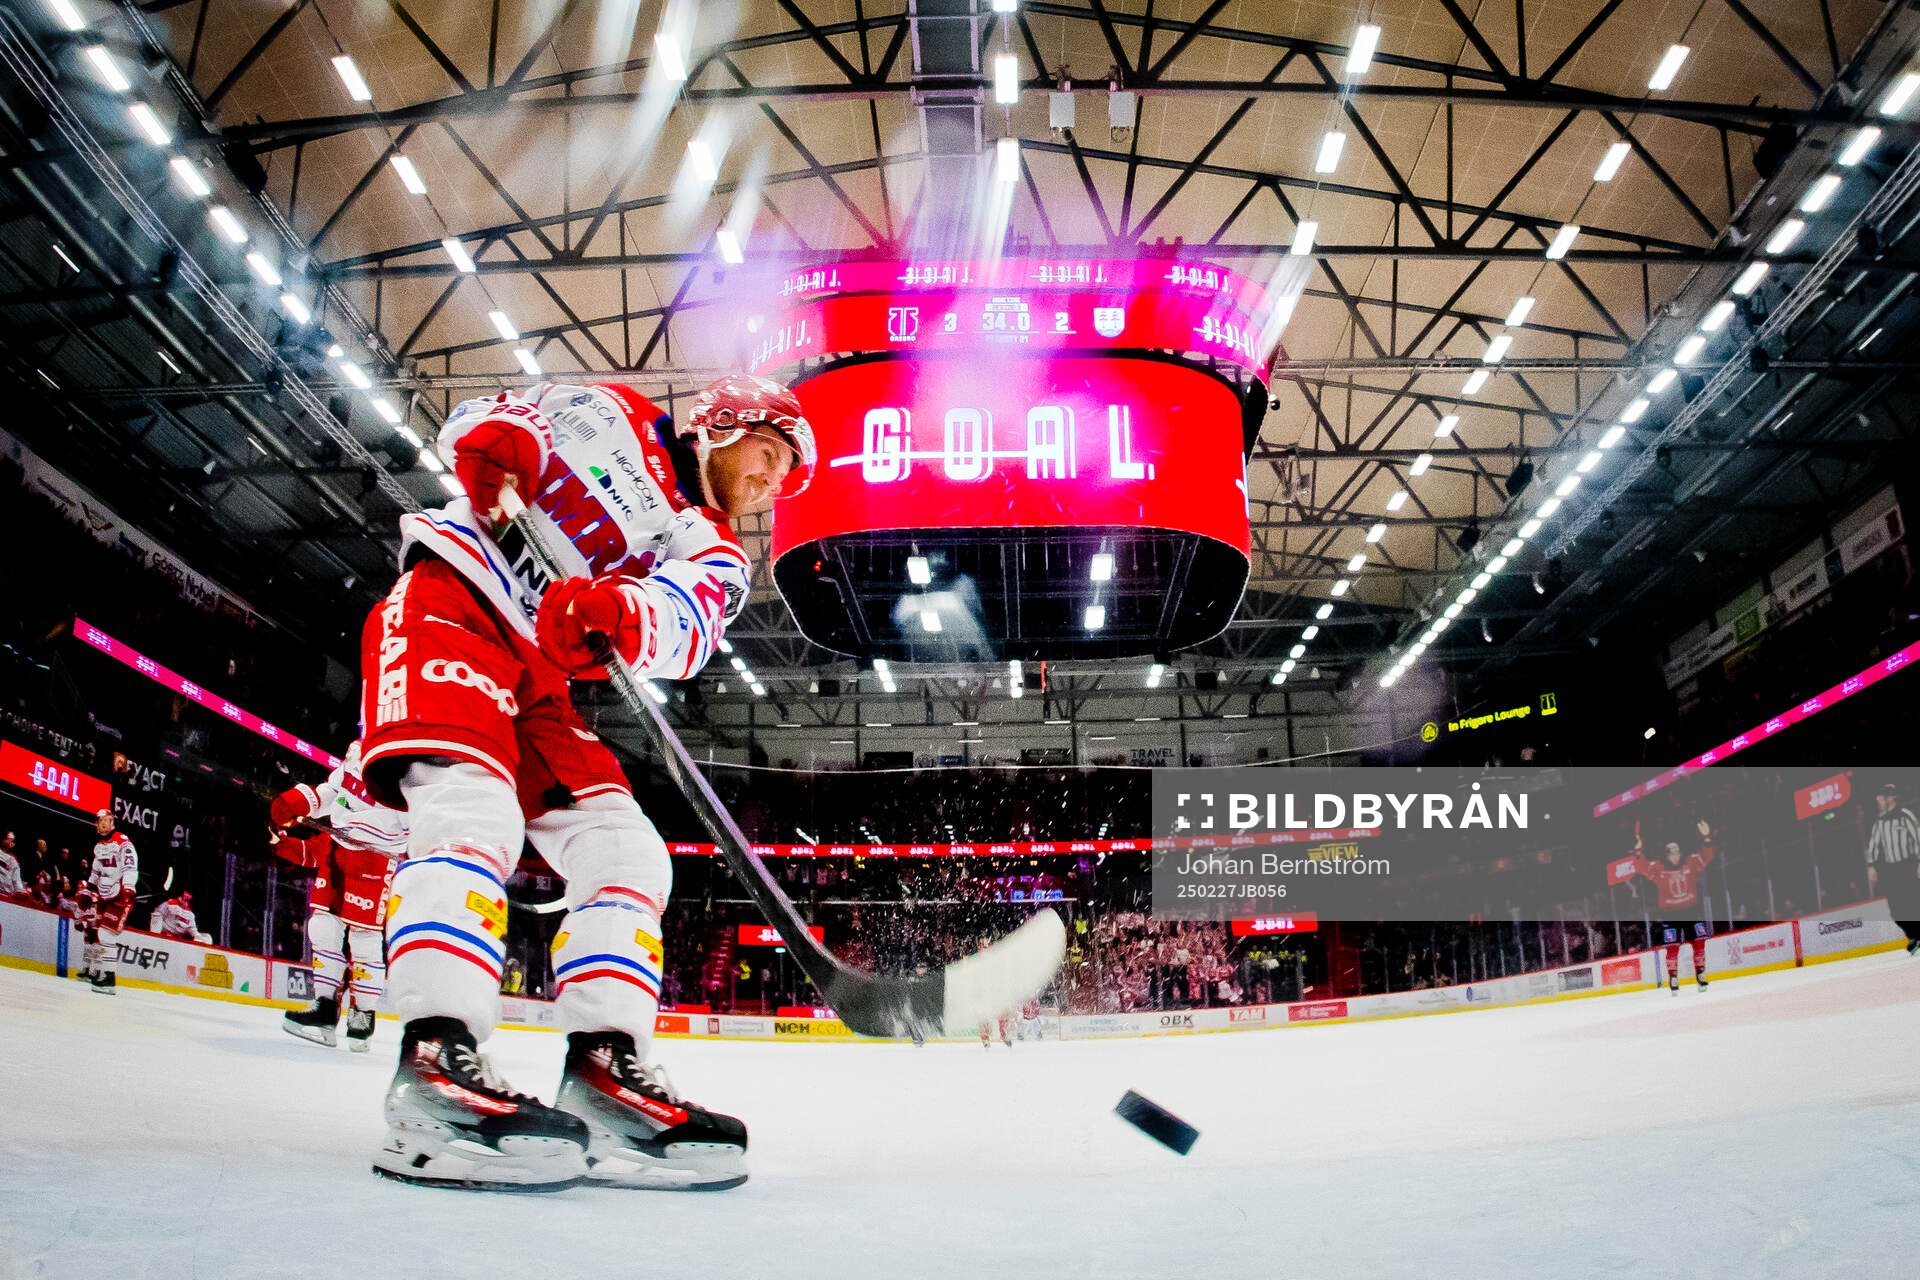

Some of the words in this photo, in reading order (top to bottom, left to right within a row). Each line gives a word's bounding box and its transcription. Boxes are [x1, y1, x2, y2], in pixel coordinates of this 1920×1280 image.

[944, 313, 957, 332] 3
[1055, 312, 1069, 331] 2
[589, 400, 617, 429] SCA
[610, 448, 660, 511] HIGHCON
[421, 658, 519, 717] coop
[1494, 705, 1532, 722] Lounge
[32, 760, 80, 801] GOAL
[114, 796, 159, 832] EXACT
[1159, 1014, 1194, 1026] OBK
